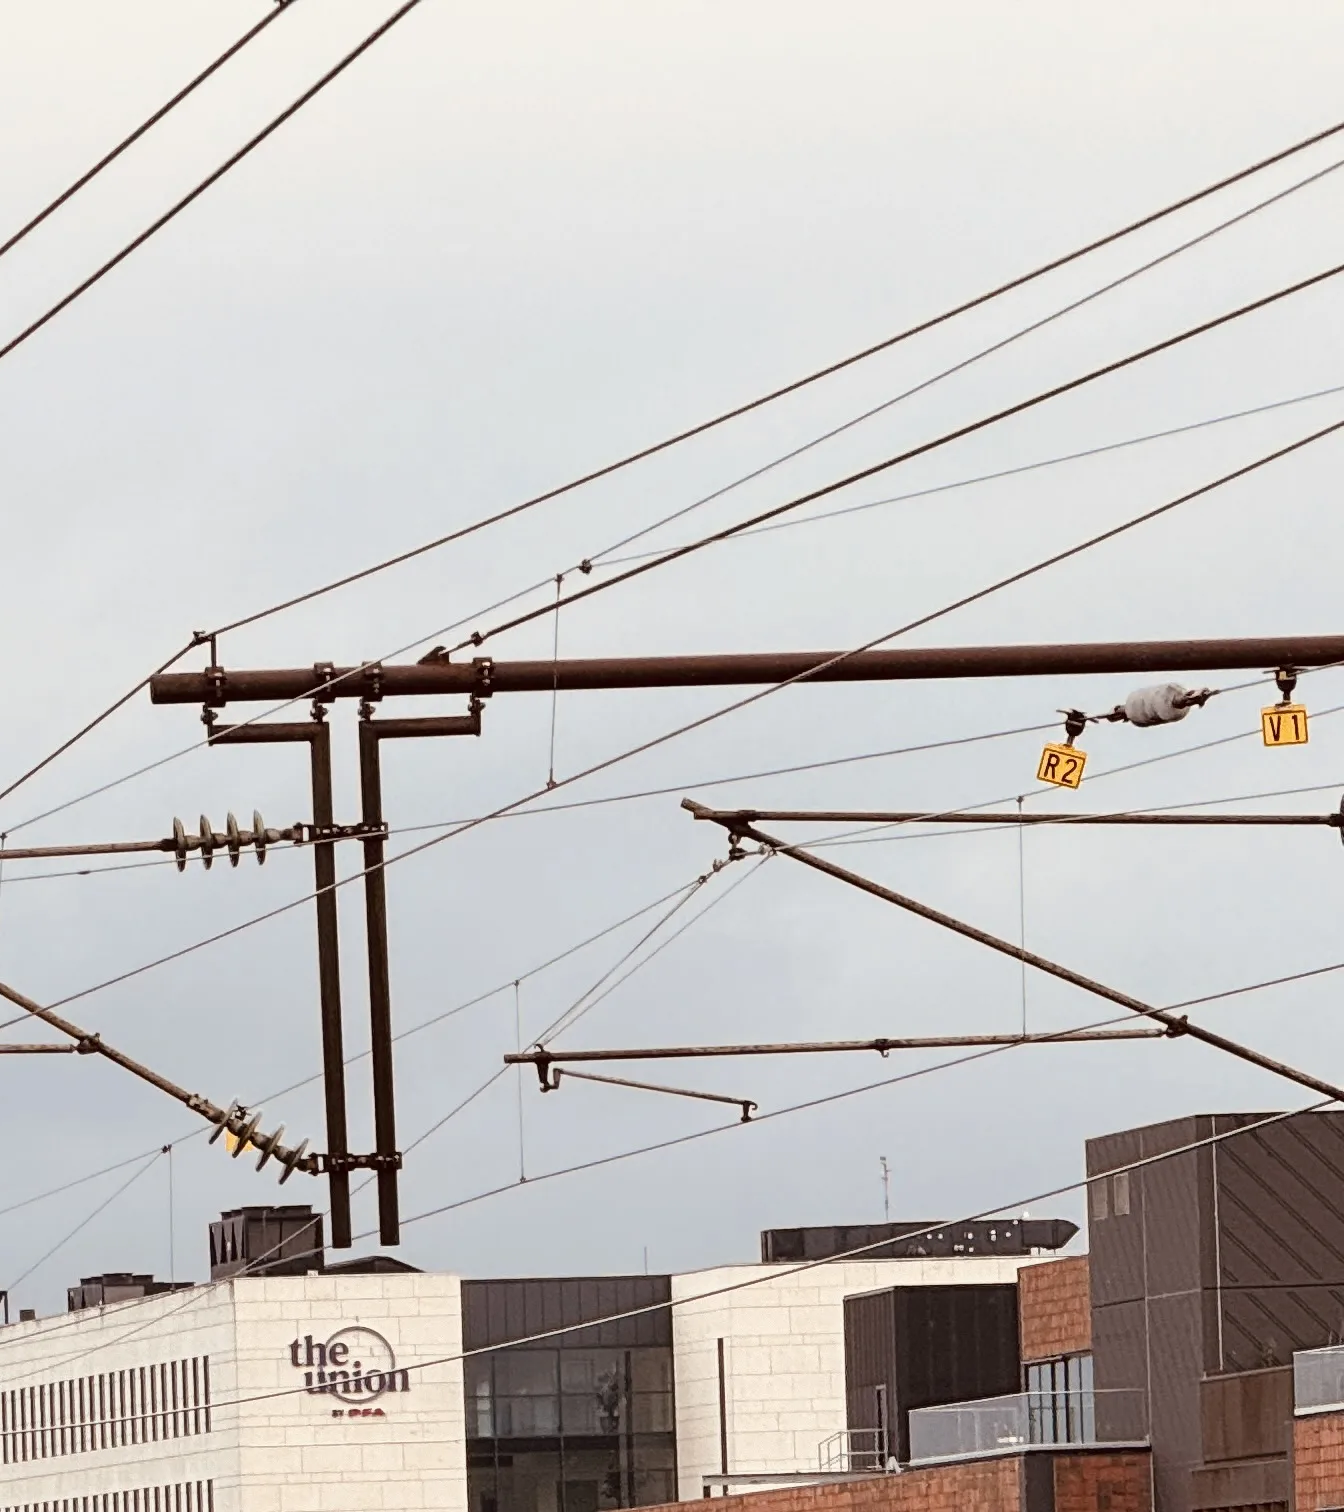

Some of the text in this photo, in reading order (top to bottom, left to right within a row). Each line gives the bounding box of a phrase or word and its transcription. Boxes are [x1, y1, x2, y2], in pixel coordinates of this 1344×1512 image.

[1268, 714, 1301, 741] V1
[1043, 754, 1078, 784] R2
[289, 1335, 349, 1367] the
[304, 1361, 410, 1394] union
